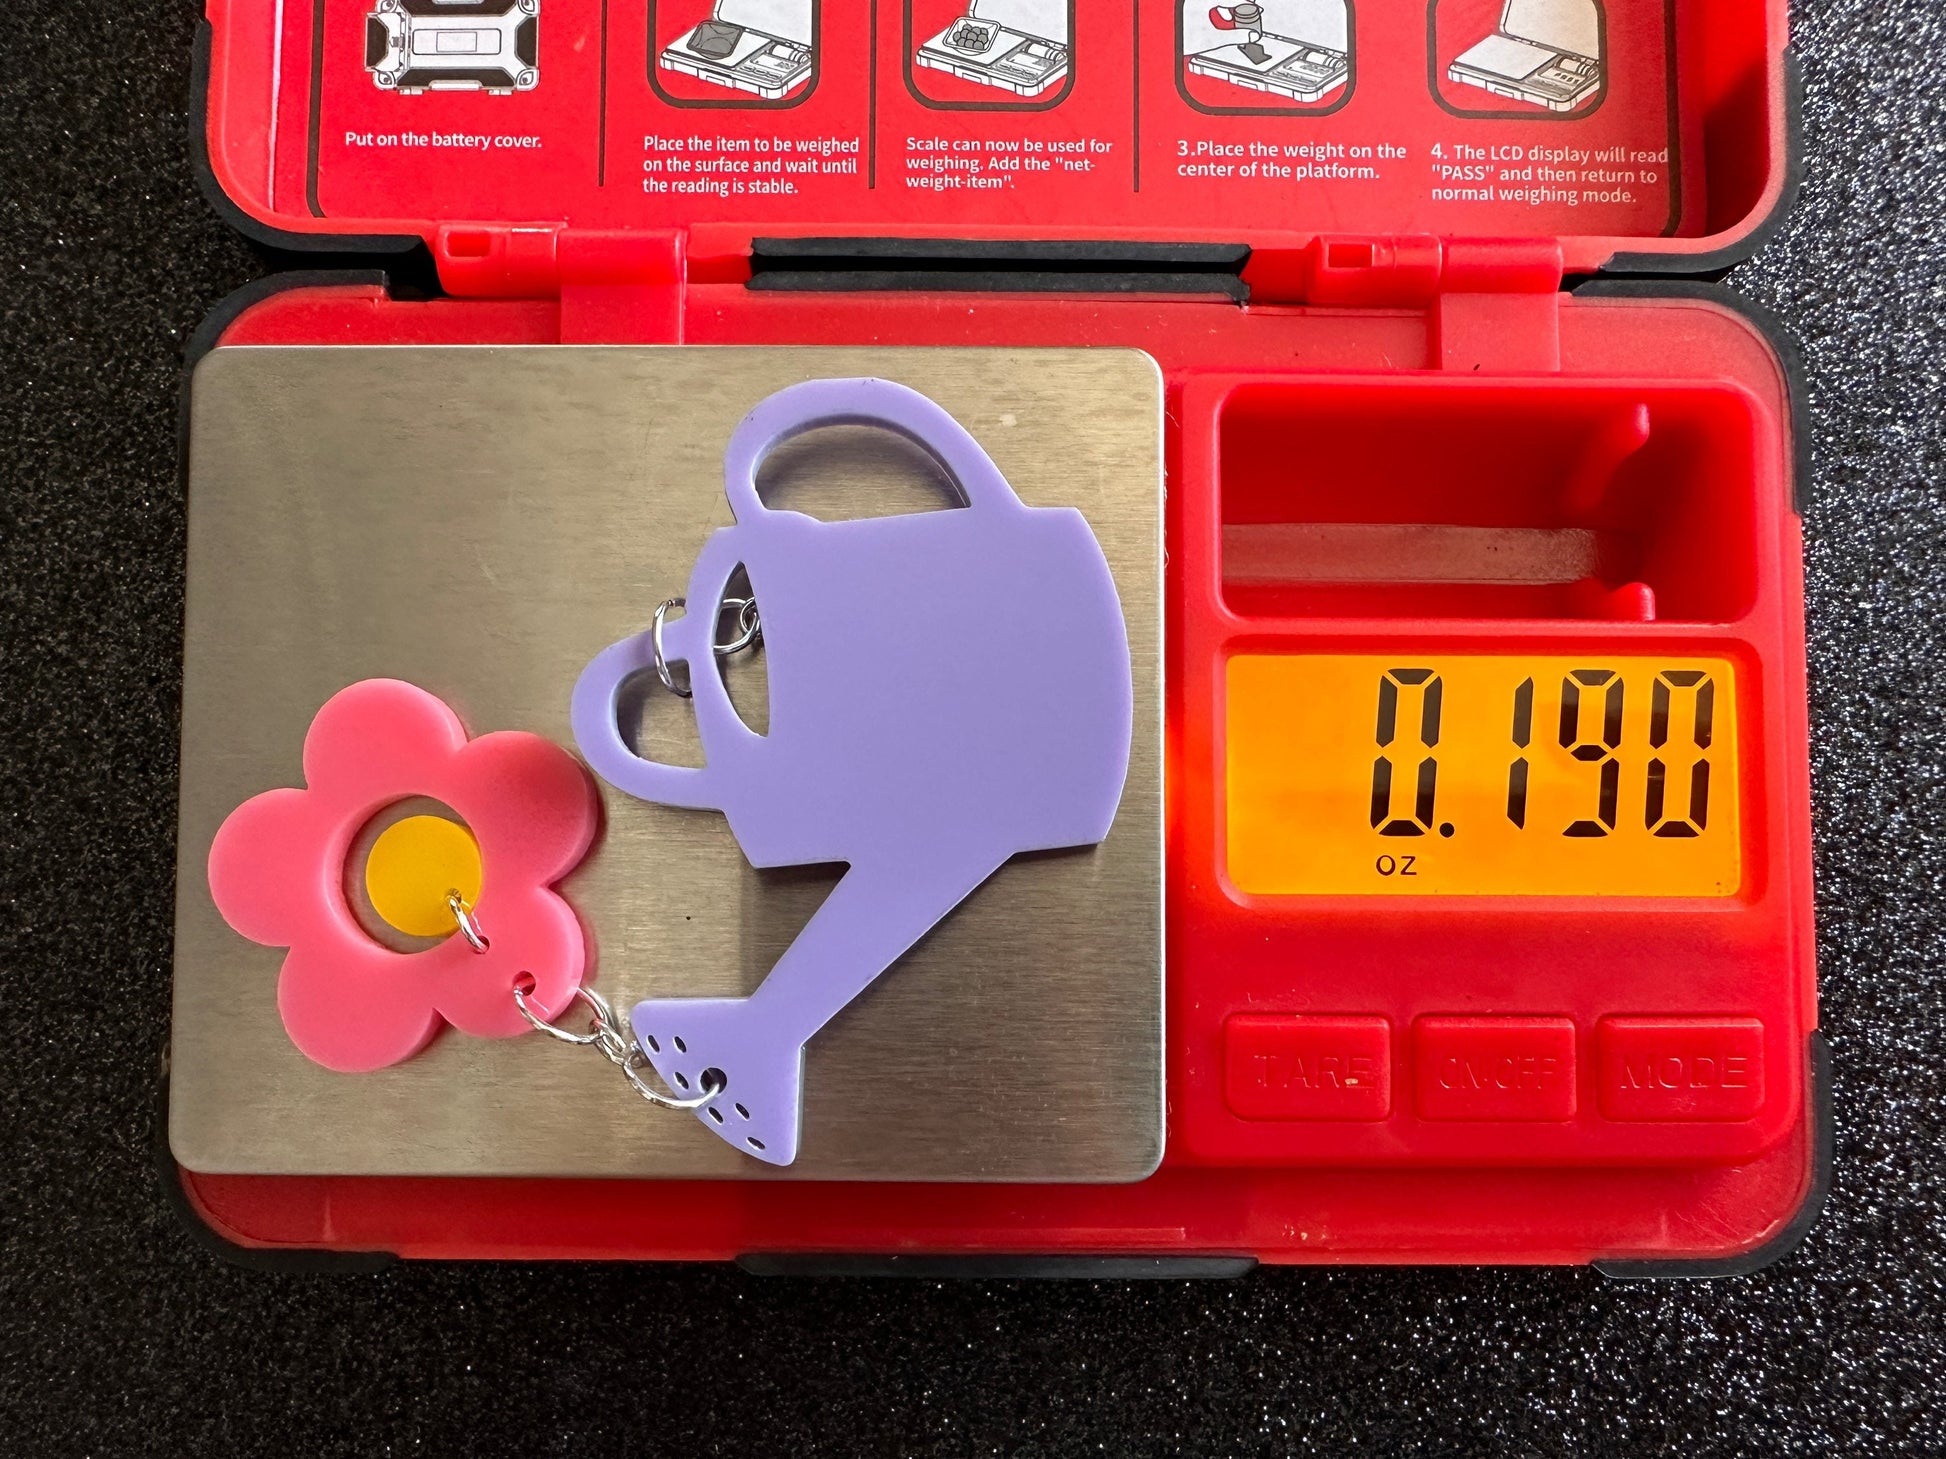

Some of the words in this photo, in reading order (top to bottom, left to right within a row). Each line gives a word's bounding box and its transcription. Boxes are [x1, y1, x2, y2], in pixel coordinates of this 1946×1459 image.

[345, 132, 373, 147] Put
[376, 134, 398, 147] on
[401, 131, 429, 147] the
[432, 131, 491, 151] battery
[494, 135, 542, 148] cover.
[644, 135, 684, 151] Place
[687, 136, 713, 152] the
[716, 135, 751, 152] item
[754, 137, 770, 152] to
[773, 137, 793, 153] be
[796, 136, 859, 157] weighed
[906, 136, 949, 151] Scale
[952, 139, 981, 152] can
[985, 140, 1020, 152] now
[1023, 137, 1044, 152] be
[1047, 138, 1086, 153] used
[1089, 138, 1113, 154] for
[1248, 141, 1279, 158] the
[1283, 141, 1346, 162] weight
[1349, 146, 1373, 159] on
[1376, 143, 1407, 159] the
[906, 154, 984, 173] weighing.
[987, 156, 1020, 171] Add
[1024, 156, 1051, 171] the
[1055, 156, 1096, 172] "net-
[1429, 142, 1449, 161] 4.
[1453, 144, 1487, 161] The
[1490, 145, 1524, 161] LCD
[1527, 145, 1590, 166] display
[1594, 146, 1626, 163] will
[1630, 147, 1668, 164] read
[643, 158, 663, 172] on
[666, 156, 693, 173] the
[695, 156, 750, 173] surface
[753, 157, 782, 173] and
[785, 157, 819, 174] wait
[822, 157, 857, 174] until
[1177, 162, 1235, 177] center
[1239, 161, 1256, 177] of
[1261, 161, 1292, 178] the
[1296, 162, 1381, 182] platform.
[1431, 164, 1495, 182] "PASS"
[1499, 165, 1533, 182] and
[1536, 166, 1577, 183] then
[1581, 168, 1635, 184] return
[1639, 169, 1658, 184] to
[642, 177, 669, 193] the
[671, 176, 729, 198] reading
[732, 177, 745, 194] is
[748, 177, 799, 195] stable.
[905, 174, 1015, 192] weight-item".
[1431, 185, 1495, 202] normal
[1498, 184, 1579, 207] weighing
[1582, 187, 1637, 204] mode.
[1370, 668, 1715, 838] 0.190
[1253, 1055, 1375, 1088] TARE
[1620, 1056, 1748, 1089] MODE
